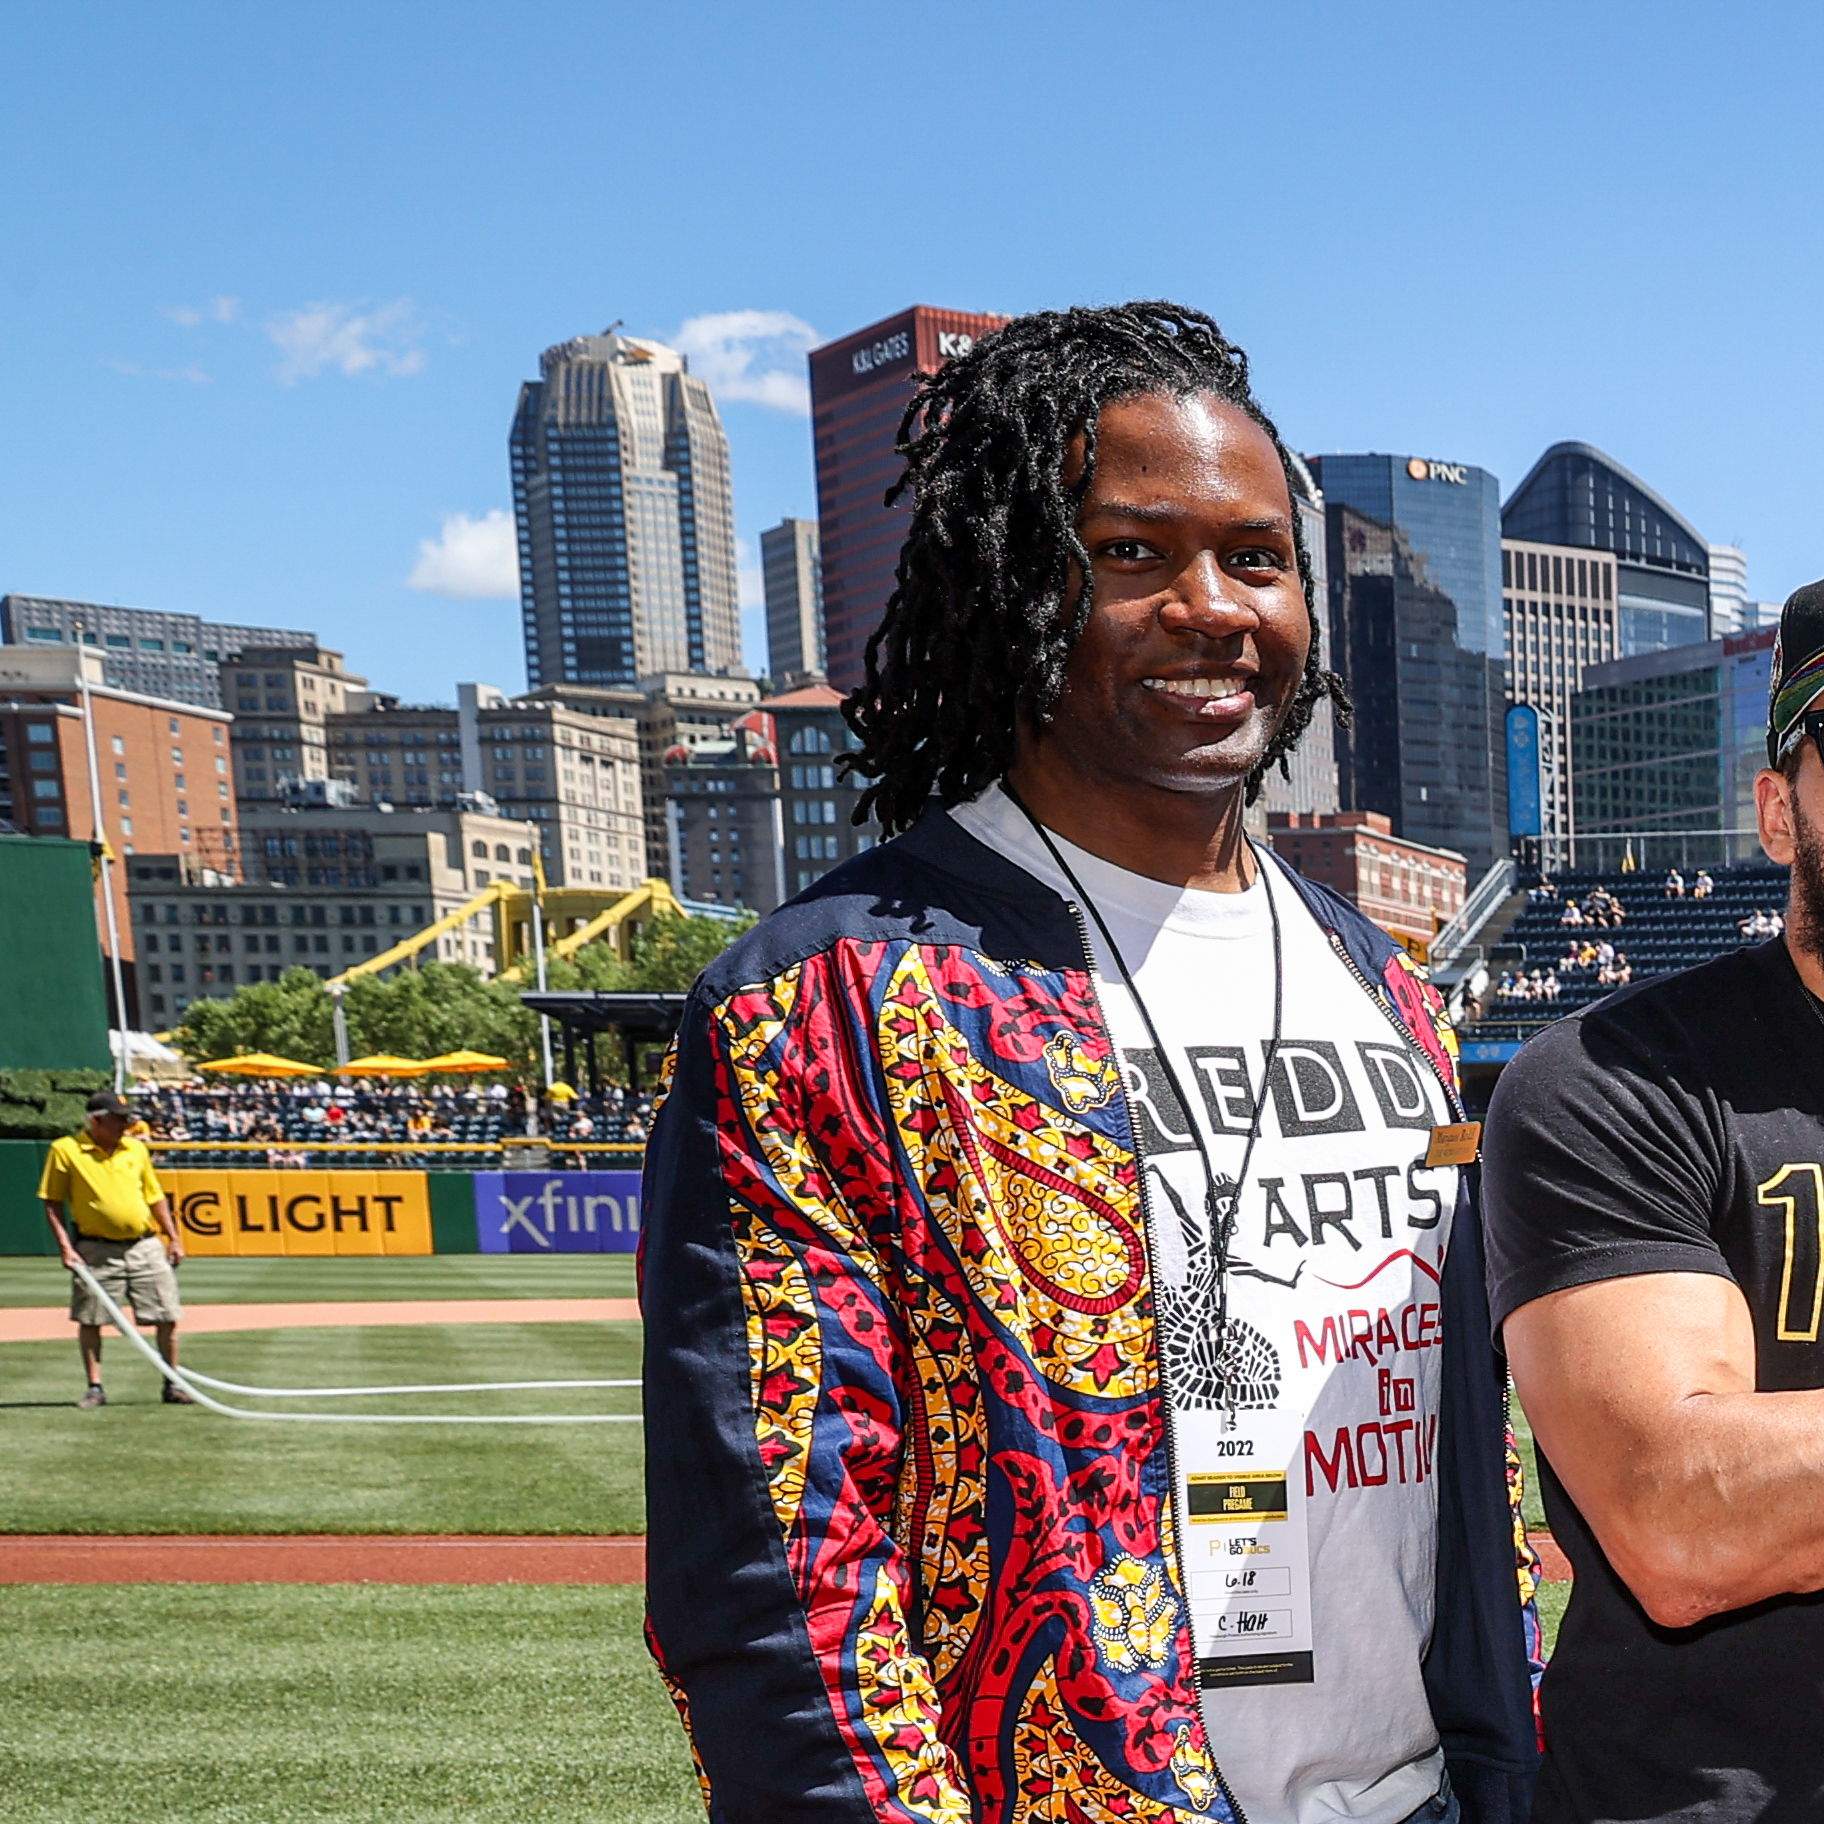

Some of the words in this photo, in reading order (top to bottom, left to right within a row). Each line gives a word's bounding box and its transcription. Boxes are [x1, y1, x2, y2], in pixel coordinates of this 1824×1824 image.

[872, 331, 909, 366] GATES
[938, 331, 973, 357] K&
[1429, 462, 1467, 485] PNC
[239, 1194, 404, 1233] LIGHT
[499, 1180, 641, 1247] xfini
[1258, 1159, 1442, 1251] ARTS
[1378, 1368, 1415, 1416] in
[1217, 1440, 1254, 1457] 2022
[1209, 1539, 1220, 1556] P
[1229, 1538, 1257, 1546] LET'S
[1225, 1571, 1256, 1587] 6.18
